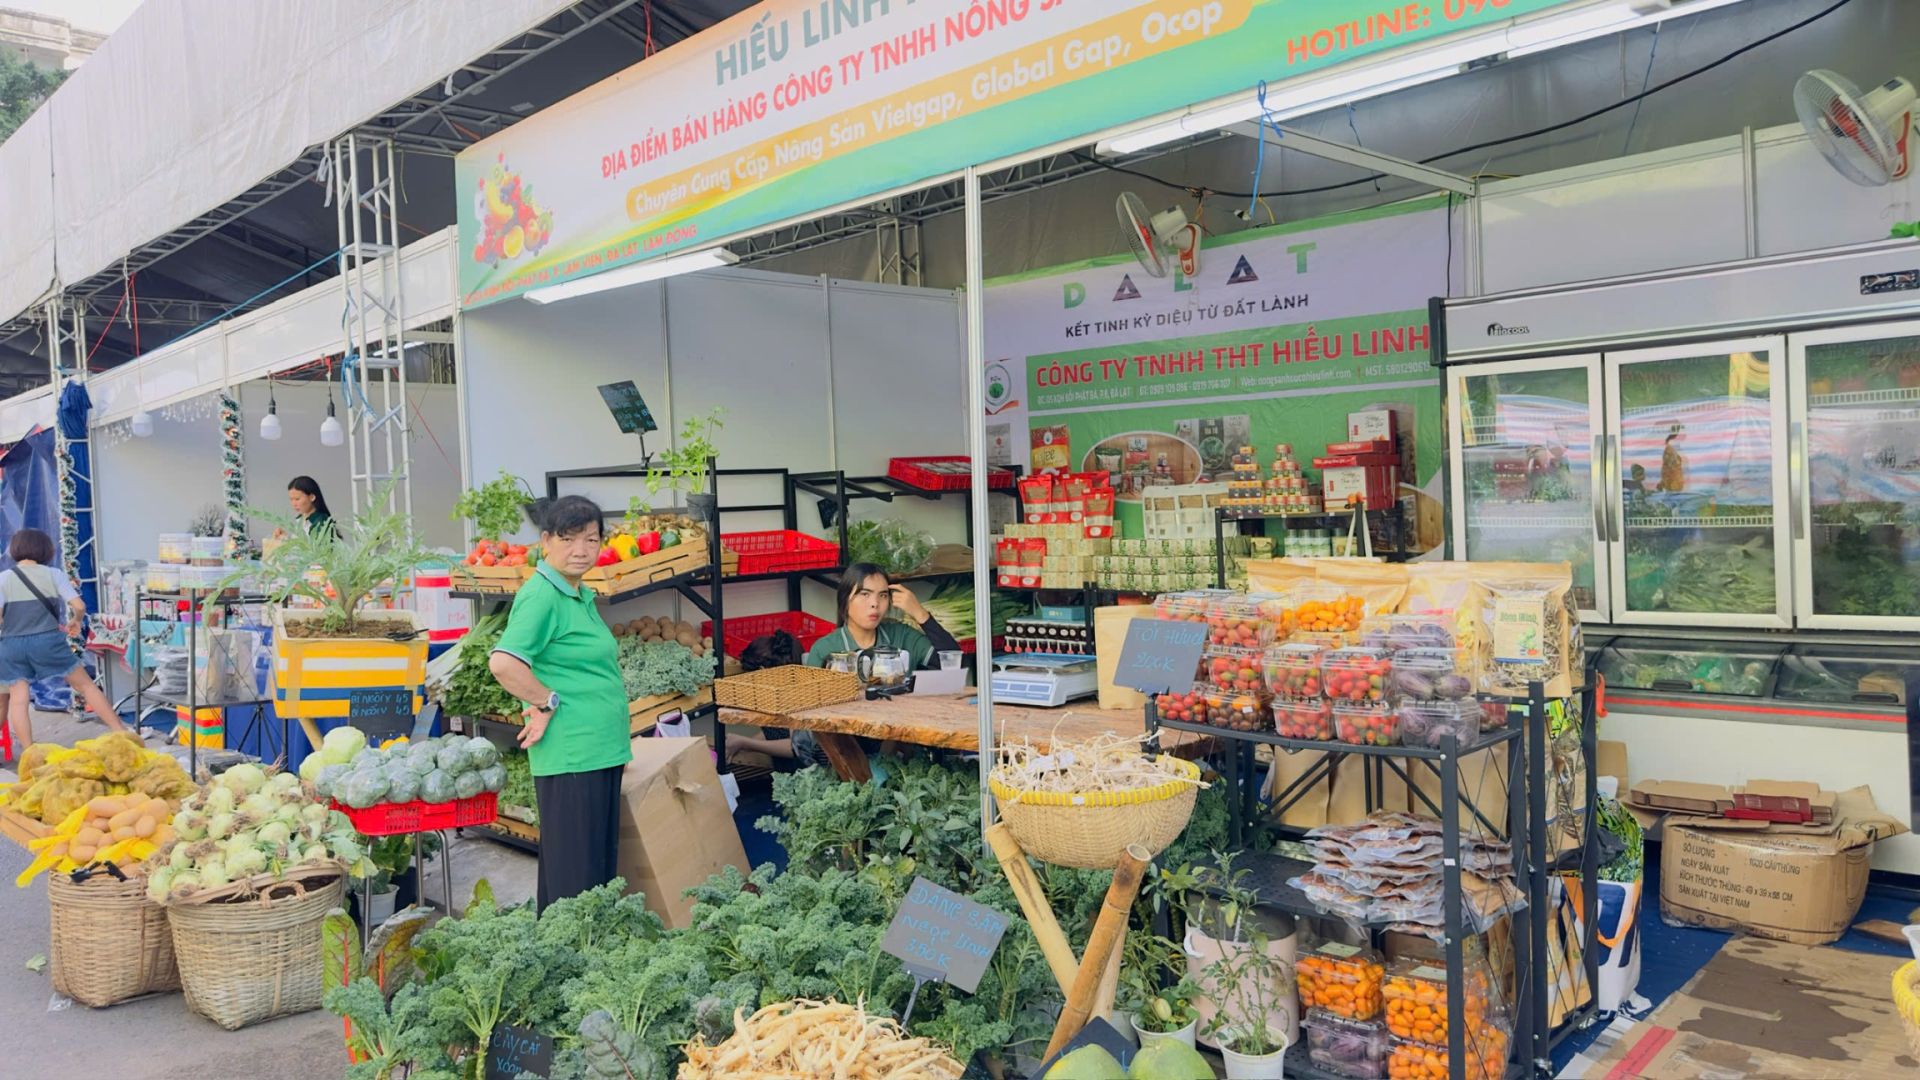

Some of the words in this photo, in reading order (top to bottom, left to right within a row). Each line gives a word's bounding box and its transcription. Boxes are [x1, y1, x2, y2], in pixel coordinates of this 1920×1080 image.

[715, 11, 789, 86] HIẾU
[1287, 3, 1431, 65] HOTLINE:
[601, 153, 627, 180] ĐỊA
[630, 127, 668, 168] ĐIỂM
[672, 114, 708, 151] BÁN
[713, 92, 767, 136] HÀNG
[773, 65, 833, 111] CÔNG
[838, 51, 865, 86] TY
[870, 23, 937, 75] TNHH
[944, 0, 1030, 47] NÔNG
[635, 183, 687, 214] Chuyên
[691, 166, 731, 193] Cung
[735, 152, 769, 180] Cấp
[774, 135, 824, 167] Nông
[829, 118, 865, 148] Sản
[872, 91, 964, 133] Vietgap,
[970, 46, 1055, 100] Global
[1063, 34, 1132, 70] Gap,
[1141, 1, 1223, 44] Ocop
[1065, 320, 1090, 338] KẾT
[1095, 319, 1129, 335] TINH
[1197, 304, 1219, 321] TỪ
[1222, 297, 1256, 317] ĐẤT
[1261, 293, 1310, 313] LÀNH
[1036, 359, 1094, 388] CÔNG
[1098, 357, 1128, 381] TY
[1133, 349, 1205, 378] TNHH
[1211, 343, 1264, 371] THT
[1271, 326, 1343, 366] HIẾU
[1351, 325, 1430, 357] LINH
